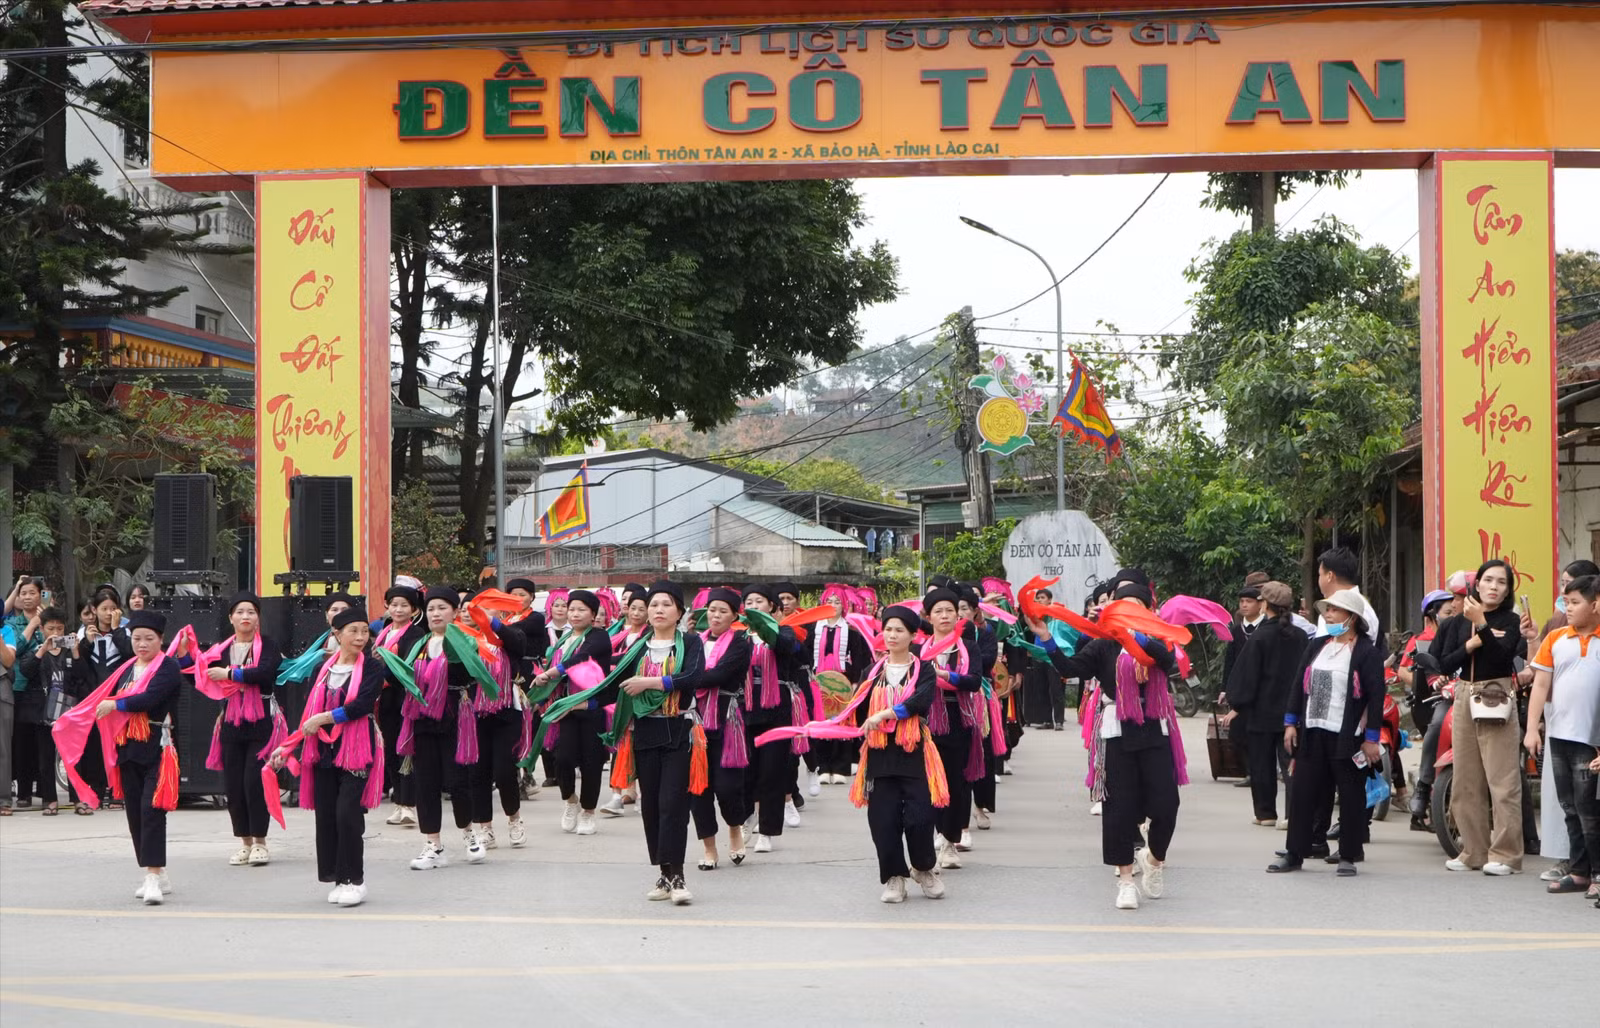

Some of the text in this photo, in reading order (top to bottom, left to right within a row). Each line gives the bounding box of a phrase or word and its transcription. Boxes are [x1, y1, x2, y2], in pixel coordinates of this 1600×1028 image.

[1130, 21, 1220, 45] GIA
[393, 47, 1406, 140] ĐỀN CÔ TÂN AN
[590, 149, 617, 163] ĐỊA
[657, 146, 699, 160] THÔN
[704, 146, 736, 160] TÂN
[741, 148, 764, 159] AN
[769, 147, 778, 158] 2
[792, 144, 815, 158] XÃ
[820, 142, 852, 158] BẢO
[858, 142, 880, 157] HÀ
[894, 140, 930, 156] TỈNH
[936, 140, 967, 155] LÀO
[973, 143, 999, 155] CAI
[290, 270, 334, 311] Cổ
[1467, 260, 1515, 304] An
[266, 394, 357, 460] Thiêng
[1462, 383, 1531, 456] Hiện
[1480, 460, 1532, 508] Rõ
[1010, 537, 1101, 558] ĐỀN CÔ TÂN AN
[1044, 564, 1064, 575] THỜ
